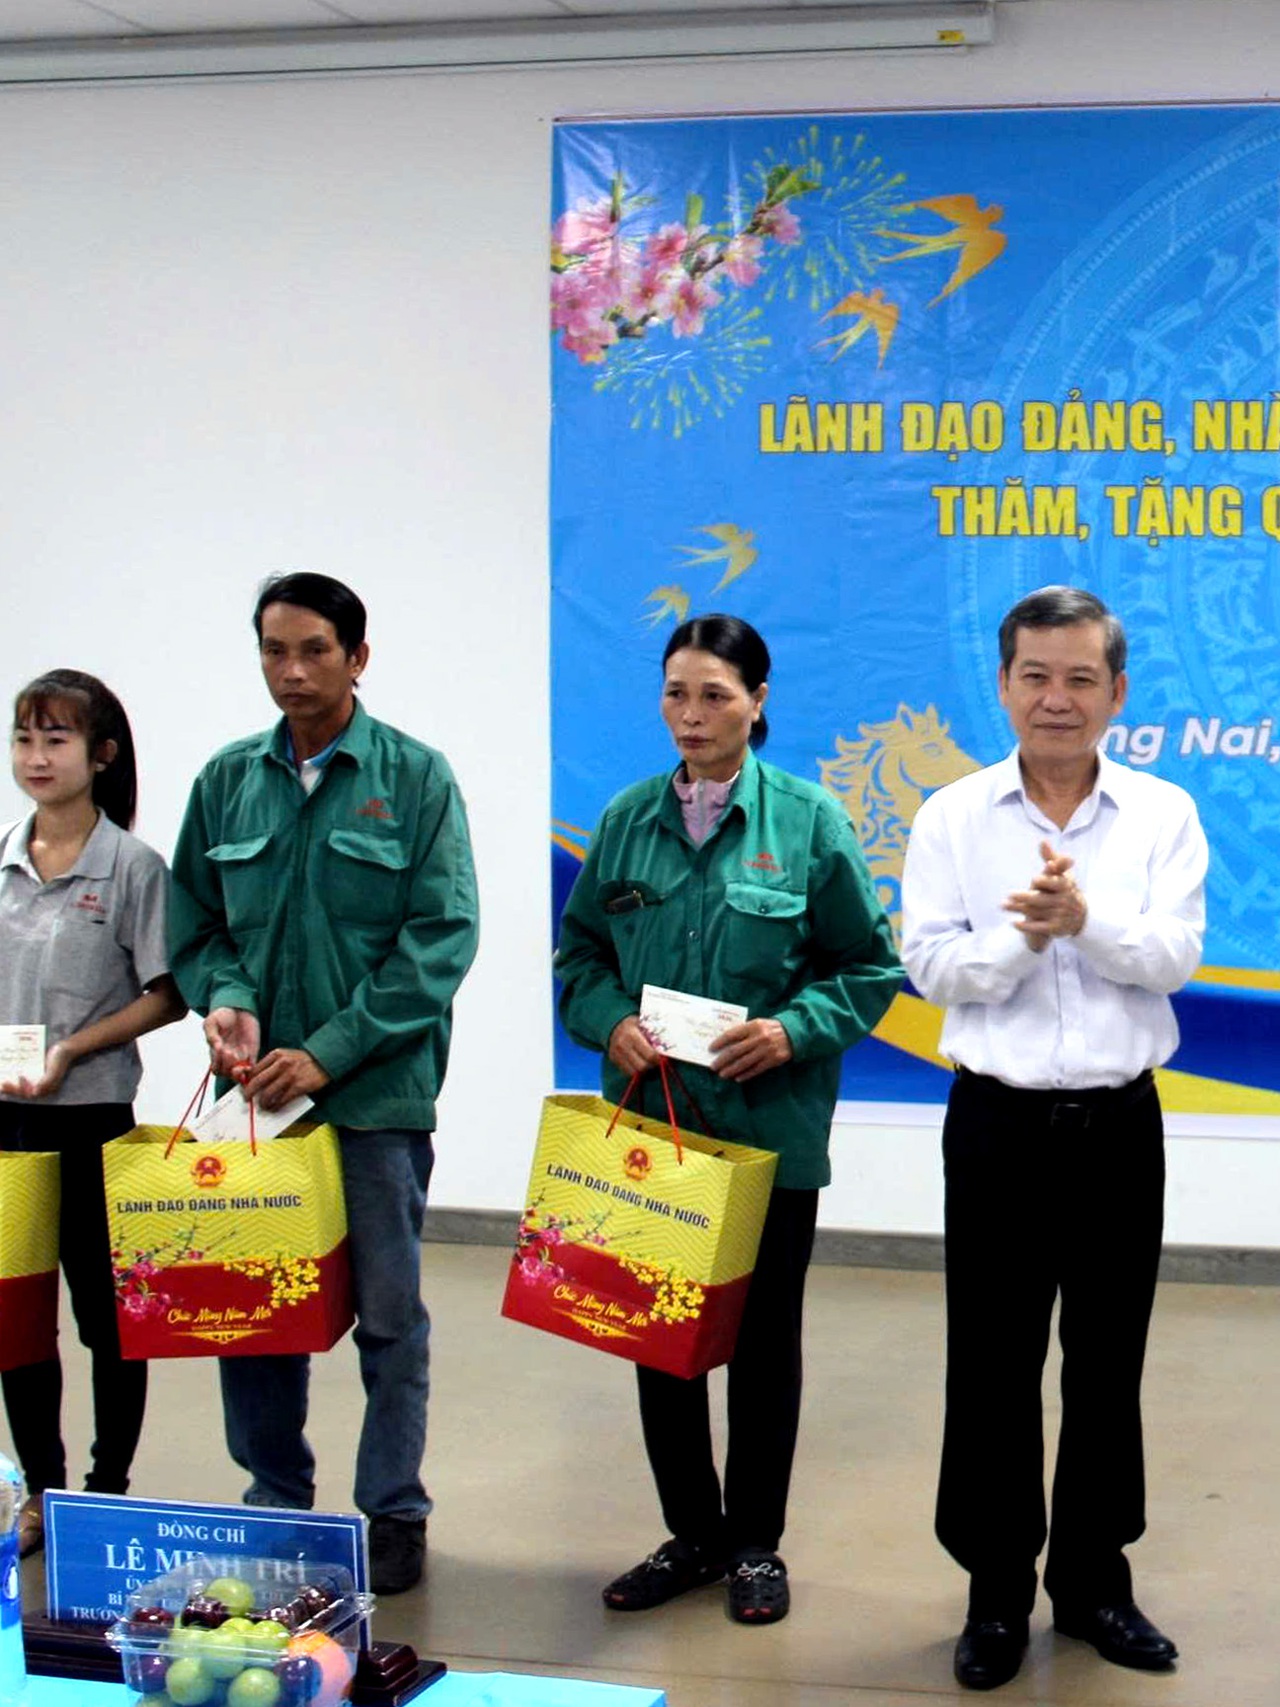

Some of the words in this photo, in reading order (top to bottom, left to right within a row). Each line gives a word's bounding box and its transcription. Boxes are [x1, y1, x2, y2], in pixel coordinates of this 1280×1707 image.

[759, 395, 884, 453] LÃNH
[901, 400, 1004, 462] ĐẠO
[1022, 388, 1177, 456] ĐẢNG,
[930, 476, 1090, 542] THĂM,
[1105, 476, 1243, 546] TẶNG
[1098, 724, 1165, 765] ng
[213, 1525, 246, 1544] CHÍ
[105, 1538, 146, 1571] LÊ
[155, 1548, 241, 1580] MINH
[255, 1552, 307, 1584] TRÍ
